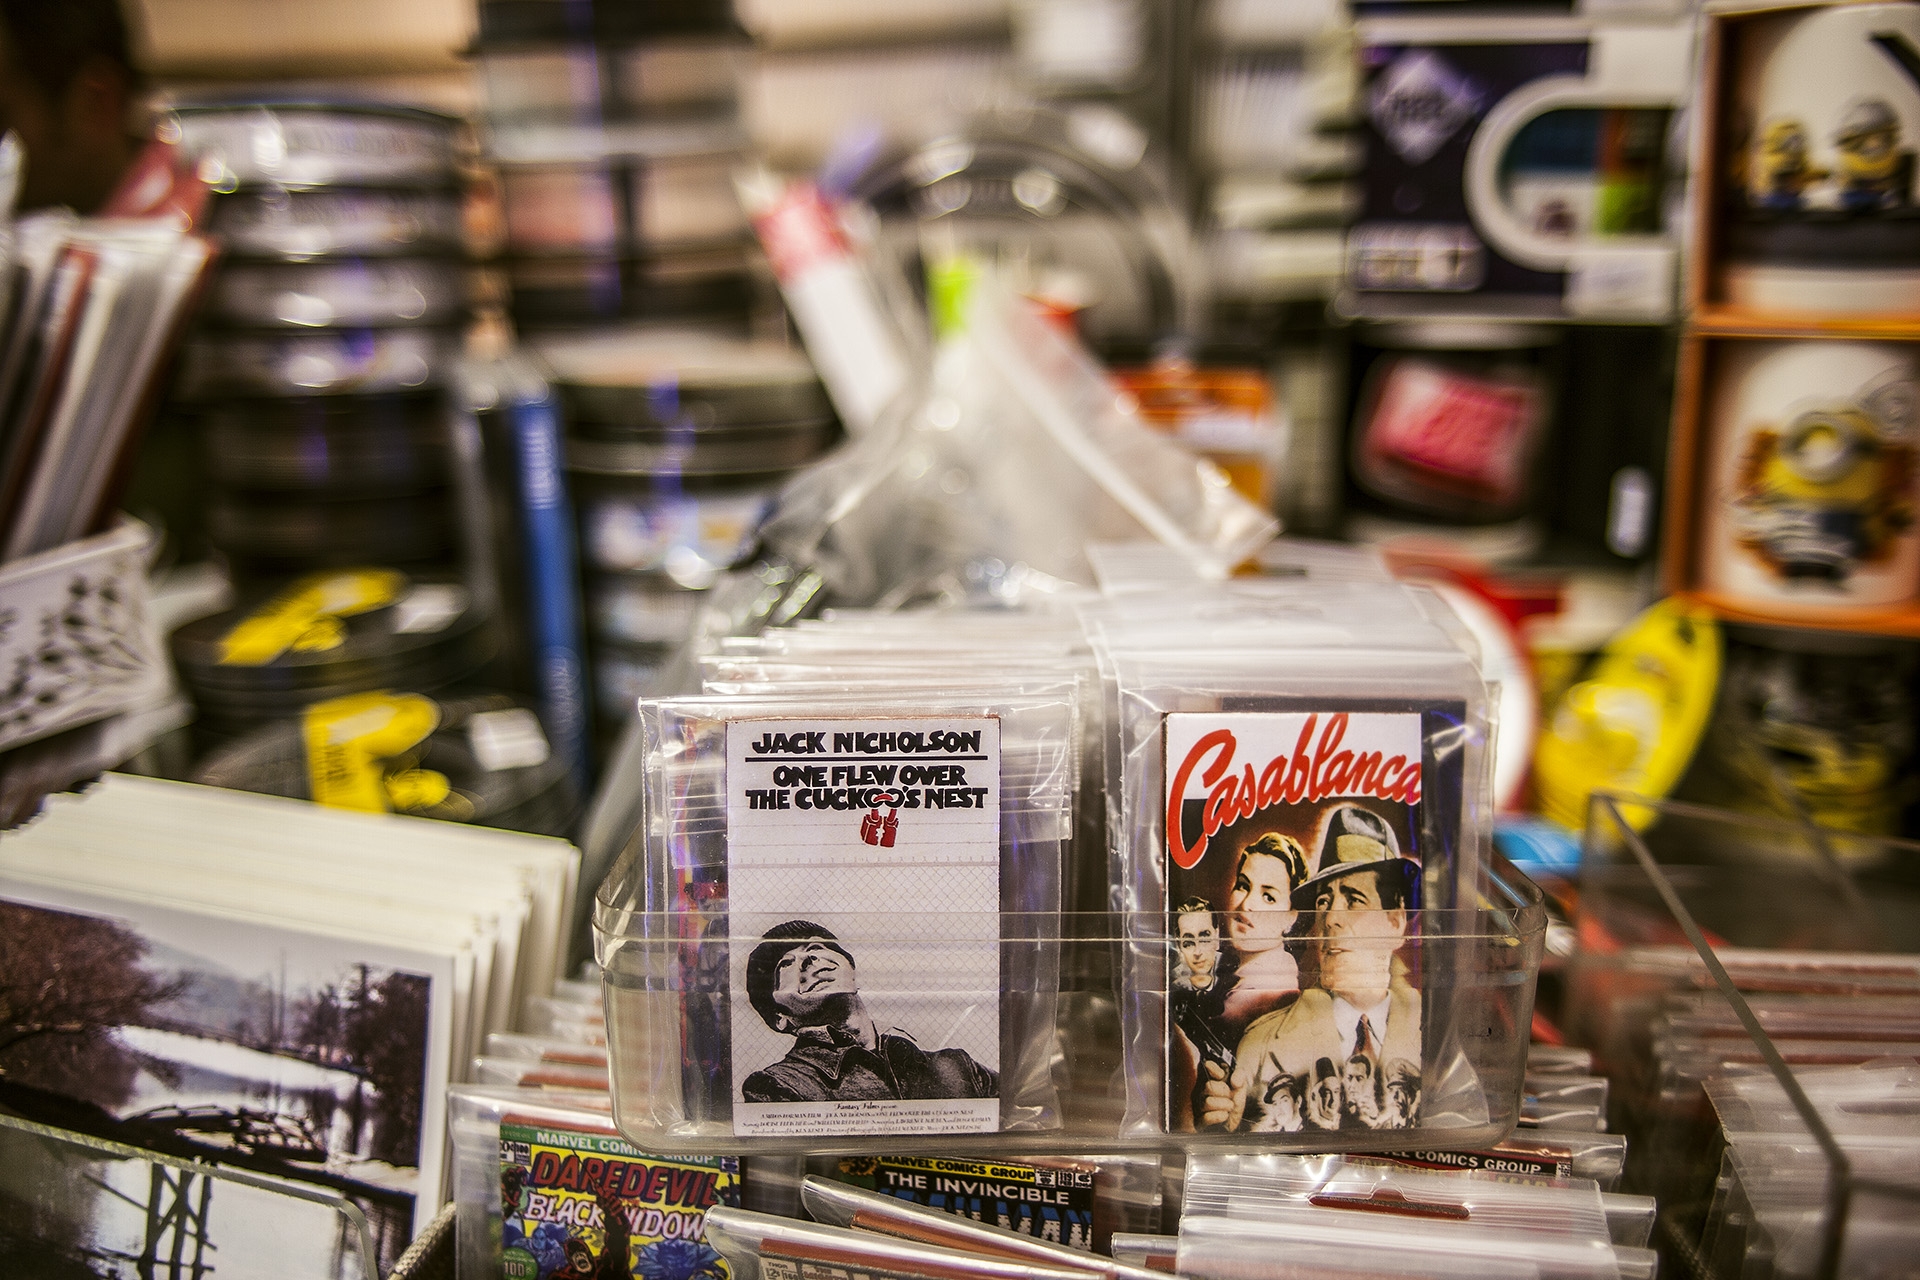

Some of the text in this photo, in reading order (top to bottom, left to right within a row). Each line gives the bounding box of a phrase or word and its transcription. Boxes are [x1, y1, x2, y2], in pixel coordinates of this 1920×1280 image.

[752, 730, 981, 754] JACK NICHOLSON
[773, 765, 968, 787] ONE FLEW OVER
[745, 785, 988, 810] THE CUCKOO'S NEST
[1167, 713, 1422, 869] Casablanca
[537, 1131, 595, 1150] MARVEL
[936, 1160, 986, 1176] COMICS
[990, 1166, 1036, 1180] GROUP
[1415, 1151, 1478, 1168] COMICS
[1484, 1159, 1541, 1174] GROUP
[528, 1151, 720, 1206] DAREDEVIL
[885, 1171, 927, 1190] THE
[936, 1176, 1069, 1205] INVINCIBLE
[524, 1193, 605, 1230] BLACK
